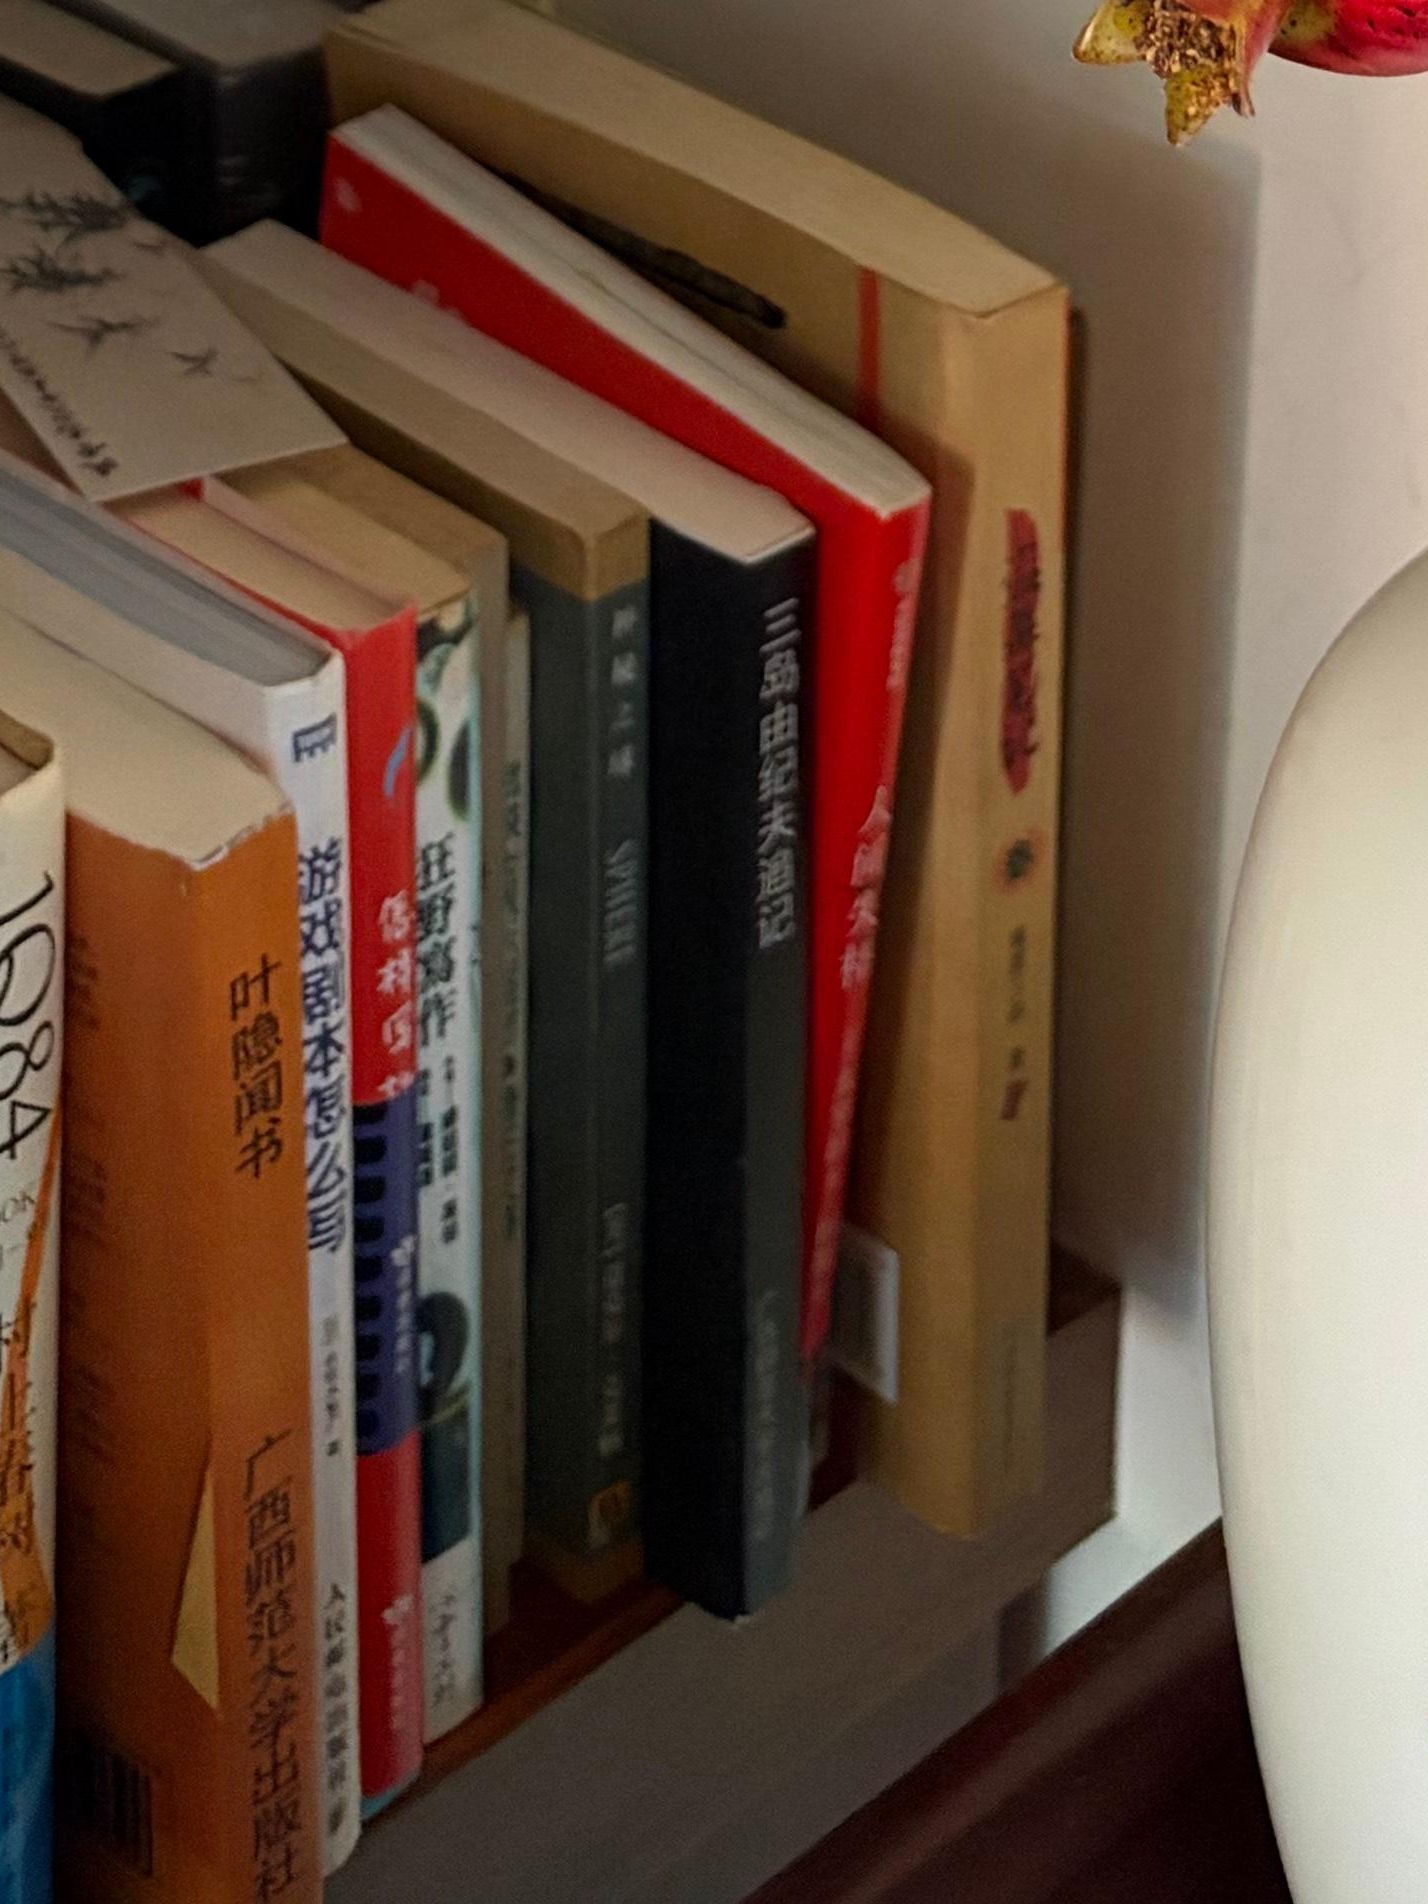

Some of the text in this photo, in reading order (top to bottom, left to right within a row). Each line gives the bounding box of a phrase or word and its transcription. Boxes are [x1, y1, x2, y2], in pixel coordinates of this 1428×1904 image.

[228, 953, 283, 1180] 叶隐闻书
[297, 840, 345, 1255] 游戏剧本怎么写
